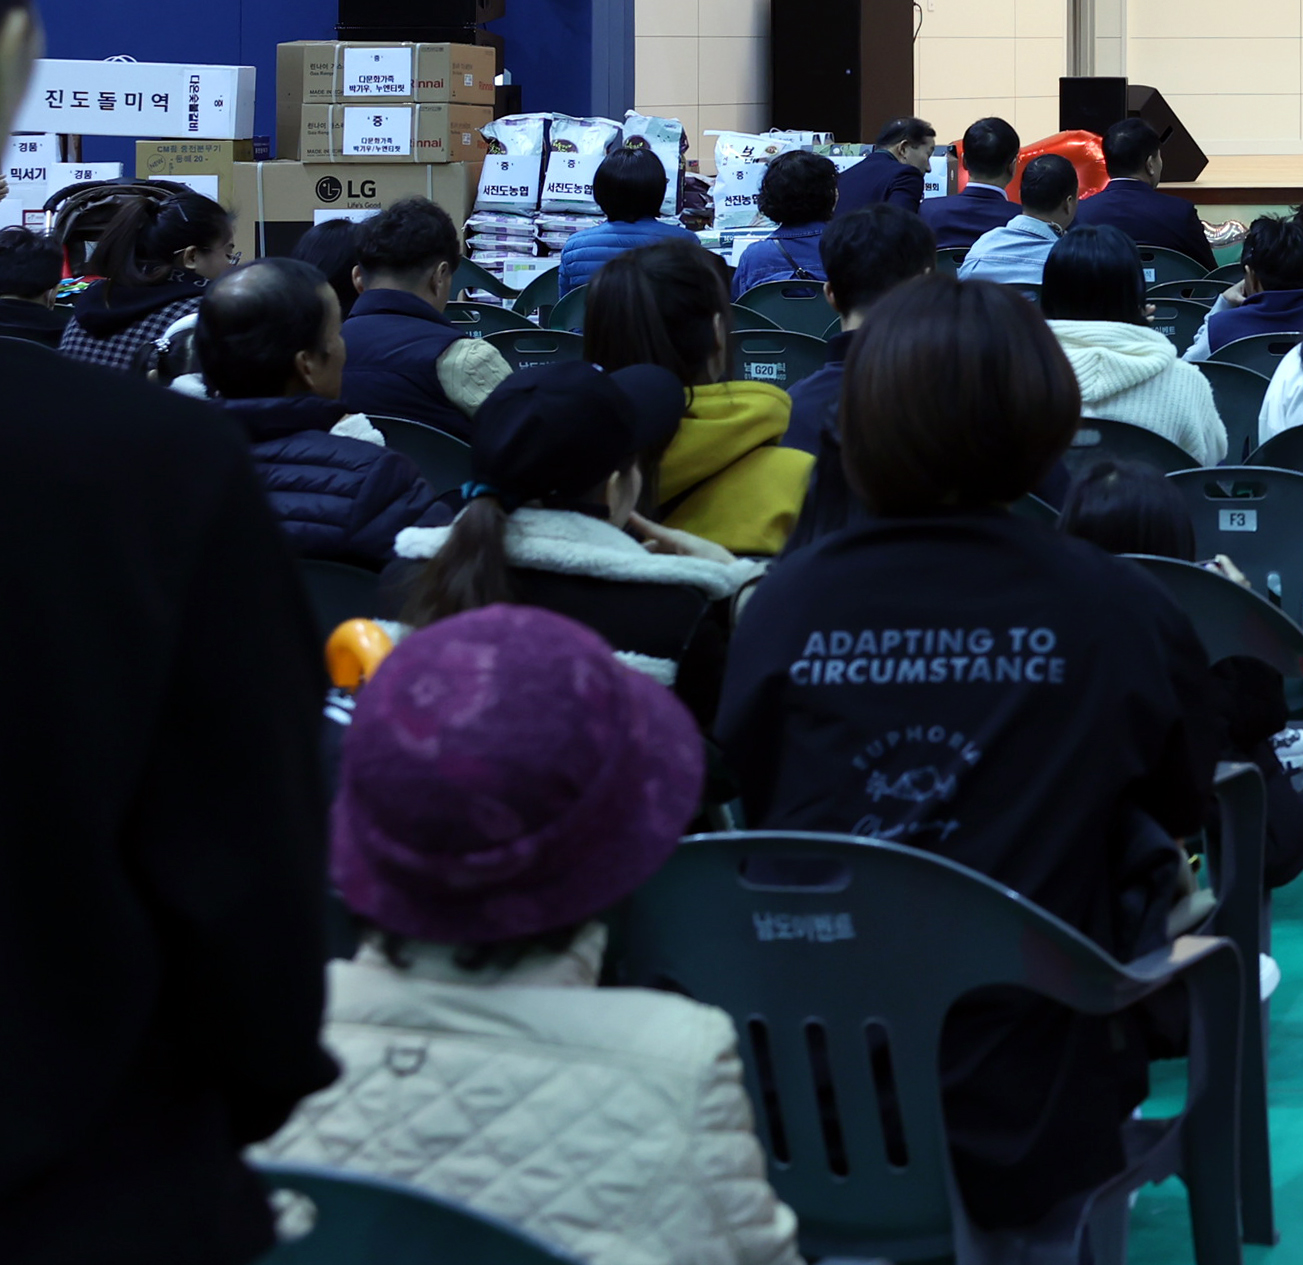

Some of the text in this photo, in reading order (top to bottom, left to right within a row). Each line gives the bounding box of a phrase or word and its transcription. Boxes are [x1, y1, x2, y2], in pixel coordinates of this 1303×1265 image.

[44, 89, 170, 113] 진도돌미역
[10, 167, 47, 181] 믹서기
[347, 180, 377, 198] LG
[483, 185, 529, 197] 서진도농협
[755, 364, 774, 376] G20
[1229, 513, 1246, 527] F3
[801, 626, 1058, 657] ADAPTING TO
[788, 655, 1067, 685] CIRCUMSTANCE
